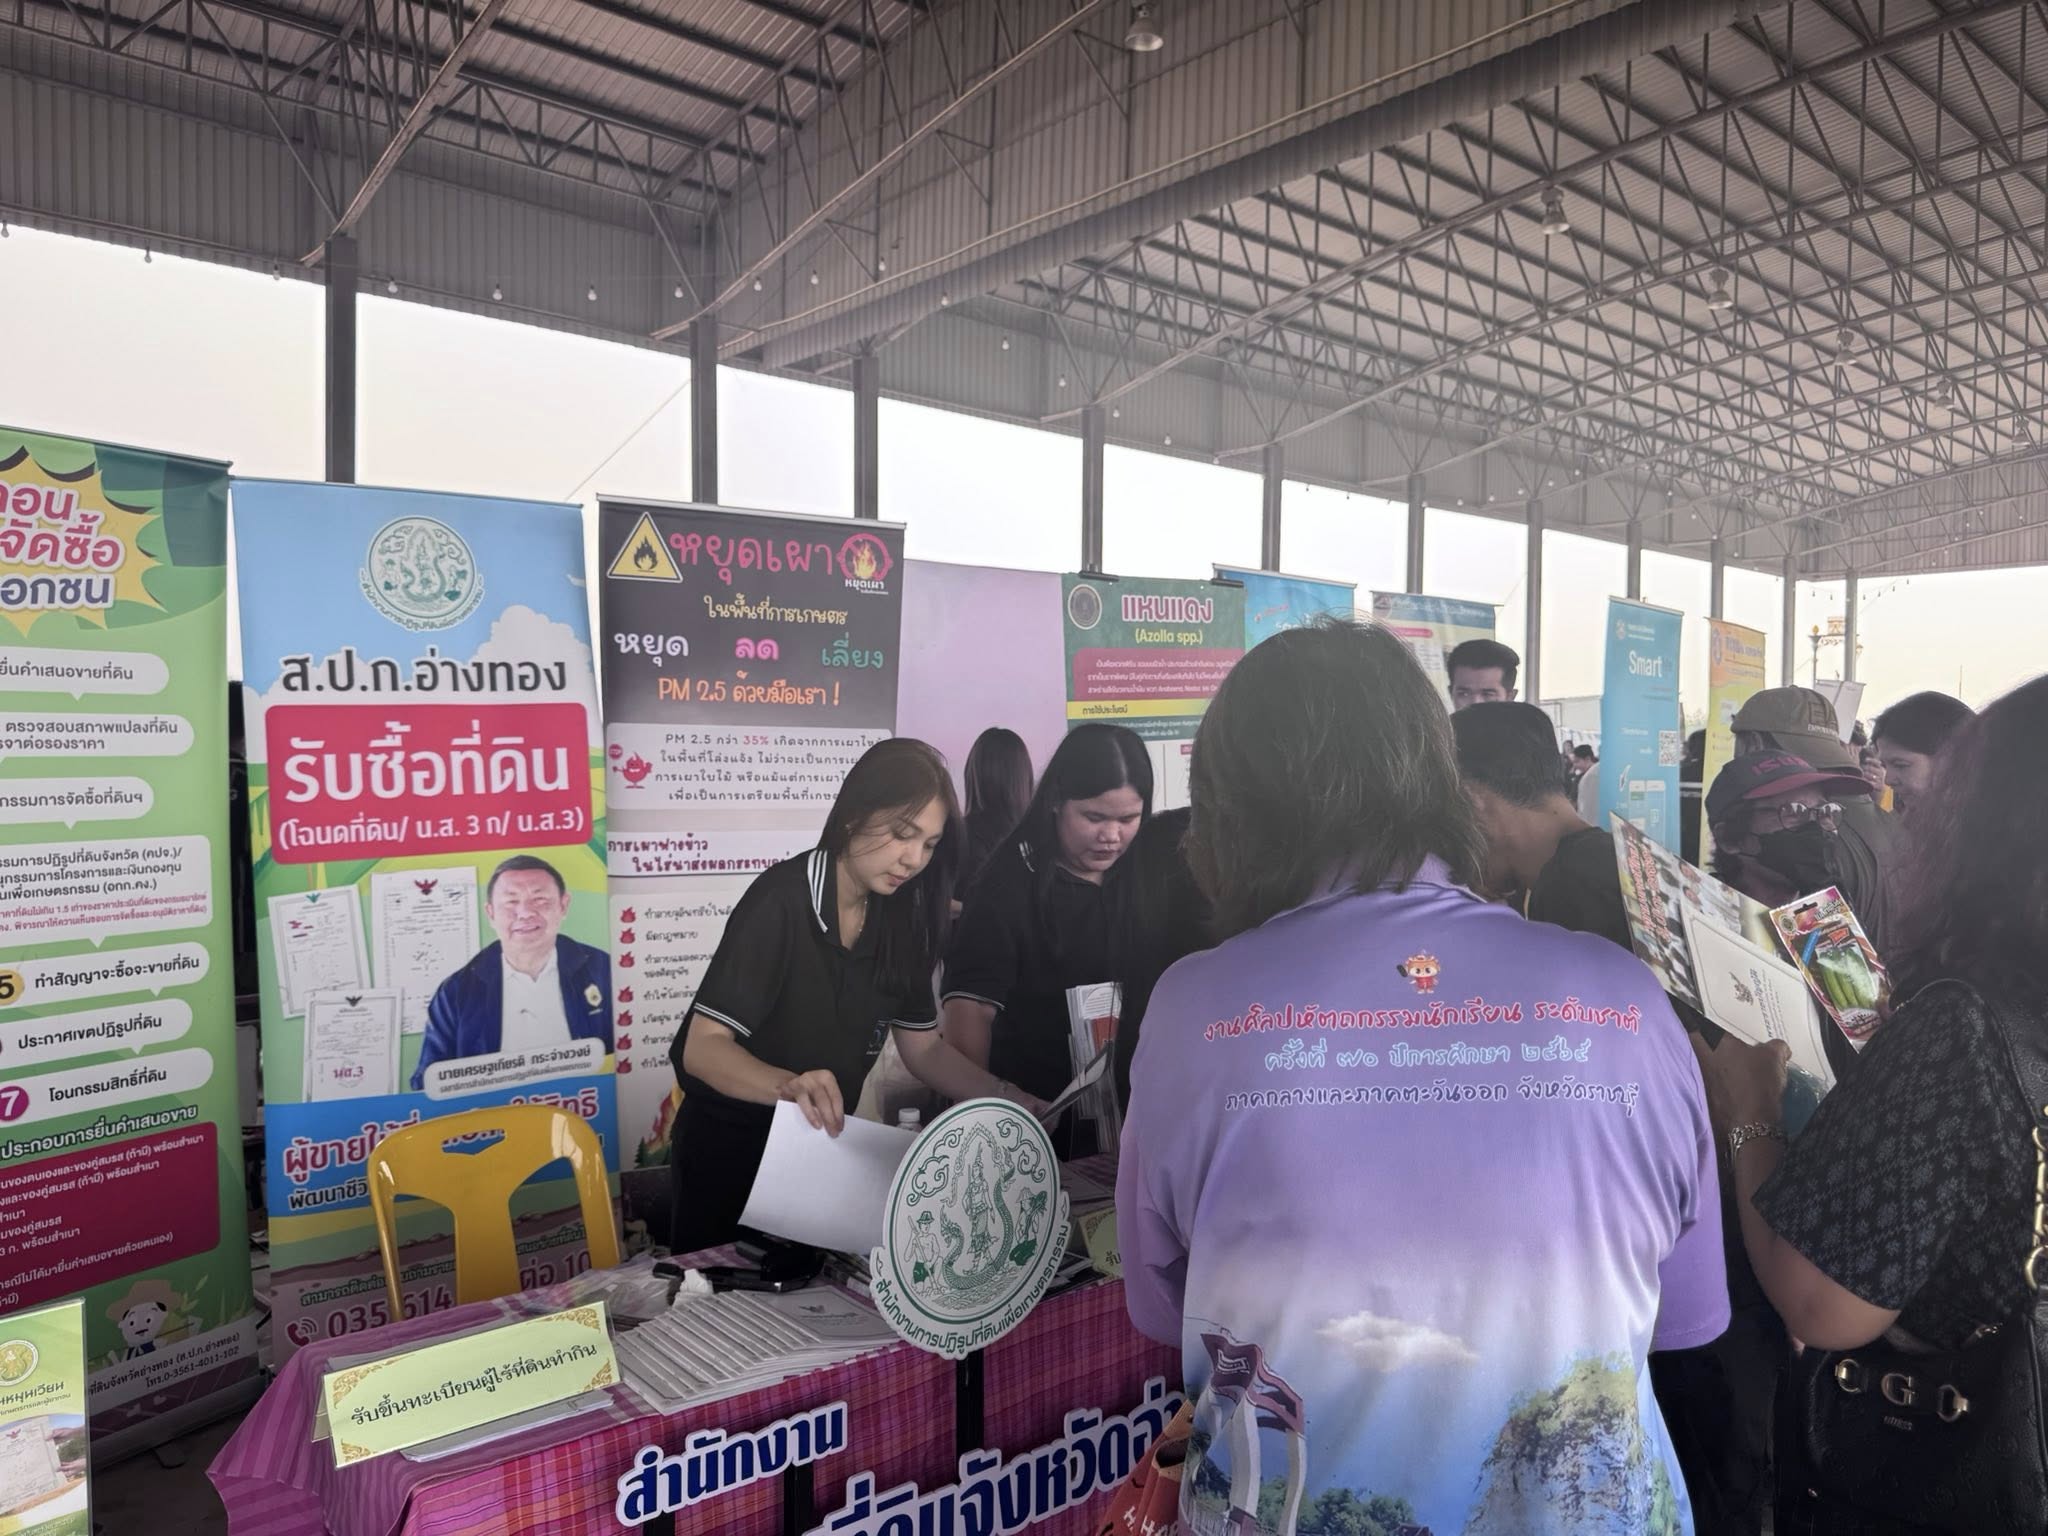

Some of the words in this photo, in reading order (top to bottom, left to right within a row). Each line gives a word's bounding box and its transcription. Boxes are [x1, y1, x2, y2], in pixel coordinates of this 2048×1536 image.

[669, 532, 833, 586] หยุดเผา
[704, 593, 848, 625] ในพื้นที่การเกษตร
[1122, 594, 1213, 622] แหนแดง
[614, 633, 689, 667] หยุด
[735, 637, 779, 660] ลด
[821, 631, 884, 669] เลี่ยง
[1135, 628, 1175, 643] (Azolla
[1177, 629, 1204, 645] spp.)
[282, 648, 567, 692] ส.ป.ก.อ่างทอง
[1628, 649, 1663, 678] Smart
[658, 677, 690, 701] PM
[696, 680, 727, 703] 2.5
[732, 669, 827, 706] ด้วยมือเรา
[5, 716, 178, 735] ตรวจสอบสภาพแปลงที่ดิน
[665, 734, 686, 744] PM
[691, 735, 712, 745] 2.5
[717, 735, 738, 746] กว่า
[743, 736, 769, 746] 35%
[284, 720, 569, 803] รับซื้อที่ดิน
[655, 769, 732, 783] การเผาใบไม้
[279, 814, 409, 850] (โฉนดที่ดิน/
[416, 820, 460, 838] น.ส.
[466, 814, 480, 834] 3
[517, 806, 584, 833] น.ส.3)
[0, 974, 14, 1000] 5
[35, 953, 200, 989] ทำสัญญาจะซื้อจะขายที่ดิน
[18, 1012, 162, 1050] ประกาศเขตปฏิรูปที่ดิน
[1204, 996, 1523, 1042] งานศิลปหัตถกรรมนักเรียน
[1534, 996, 1642, 1036] ระดับชาติ
[1264, 1036, 1328, 1072] ครั้งที่
[1388, 1041, 1511, 1067] ปีการศึกษา
[1, 1088, 20, 1118] 7
[49, 1066, 167, 1102] โอนกรรมสิทธิ์ที่ดิน
[1225, 1078, 1508, 1111] ภาคกลางและภาคตะวันออก
[875, 1223, 1070, 1354] สำนักงานการปฏิรูปที่ดินเพื่อเกษตรกรรม
[350, 1343, 598, 1426] รับขึ้นทะเบียนผู้ไร้ที่ดินทำกิน
[622, 1407, 844, 1522] สำนักงาน
